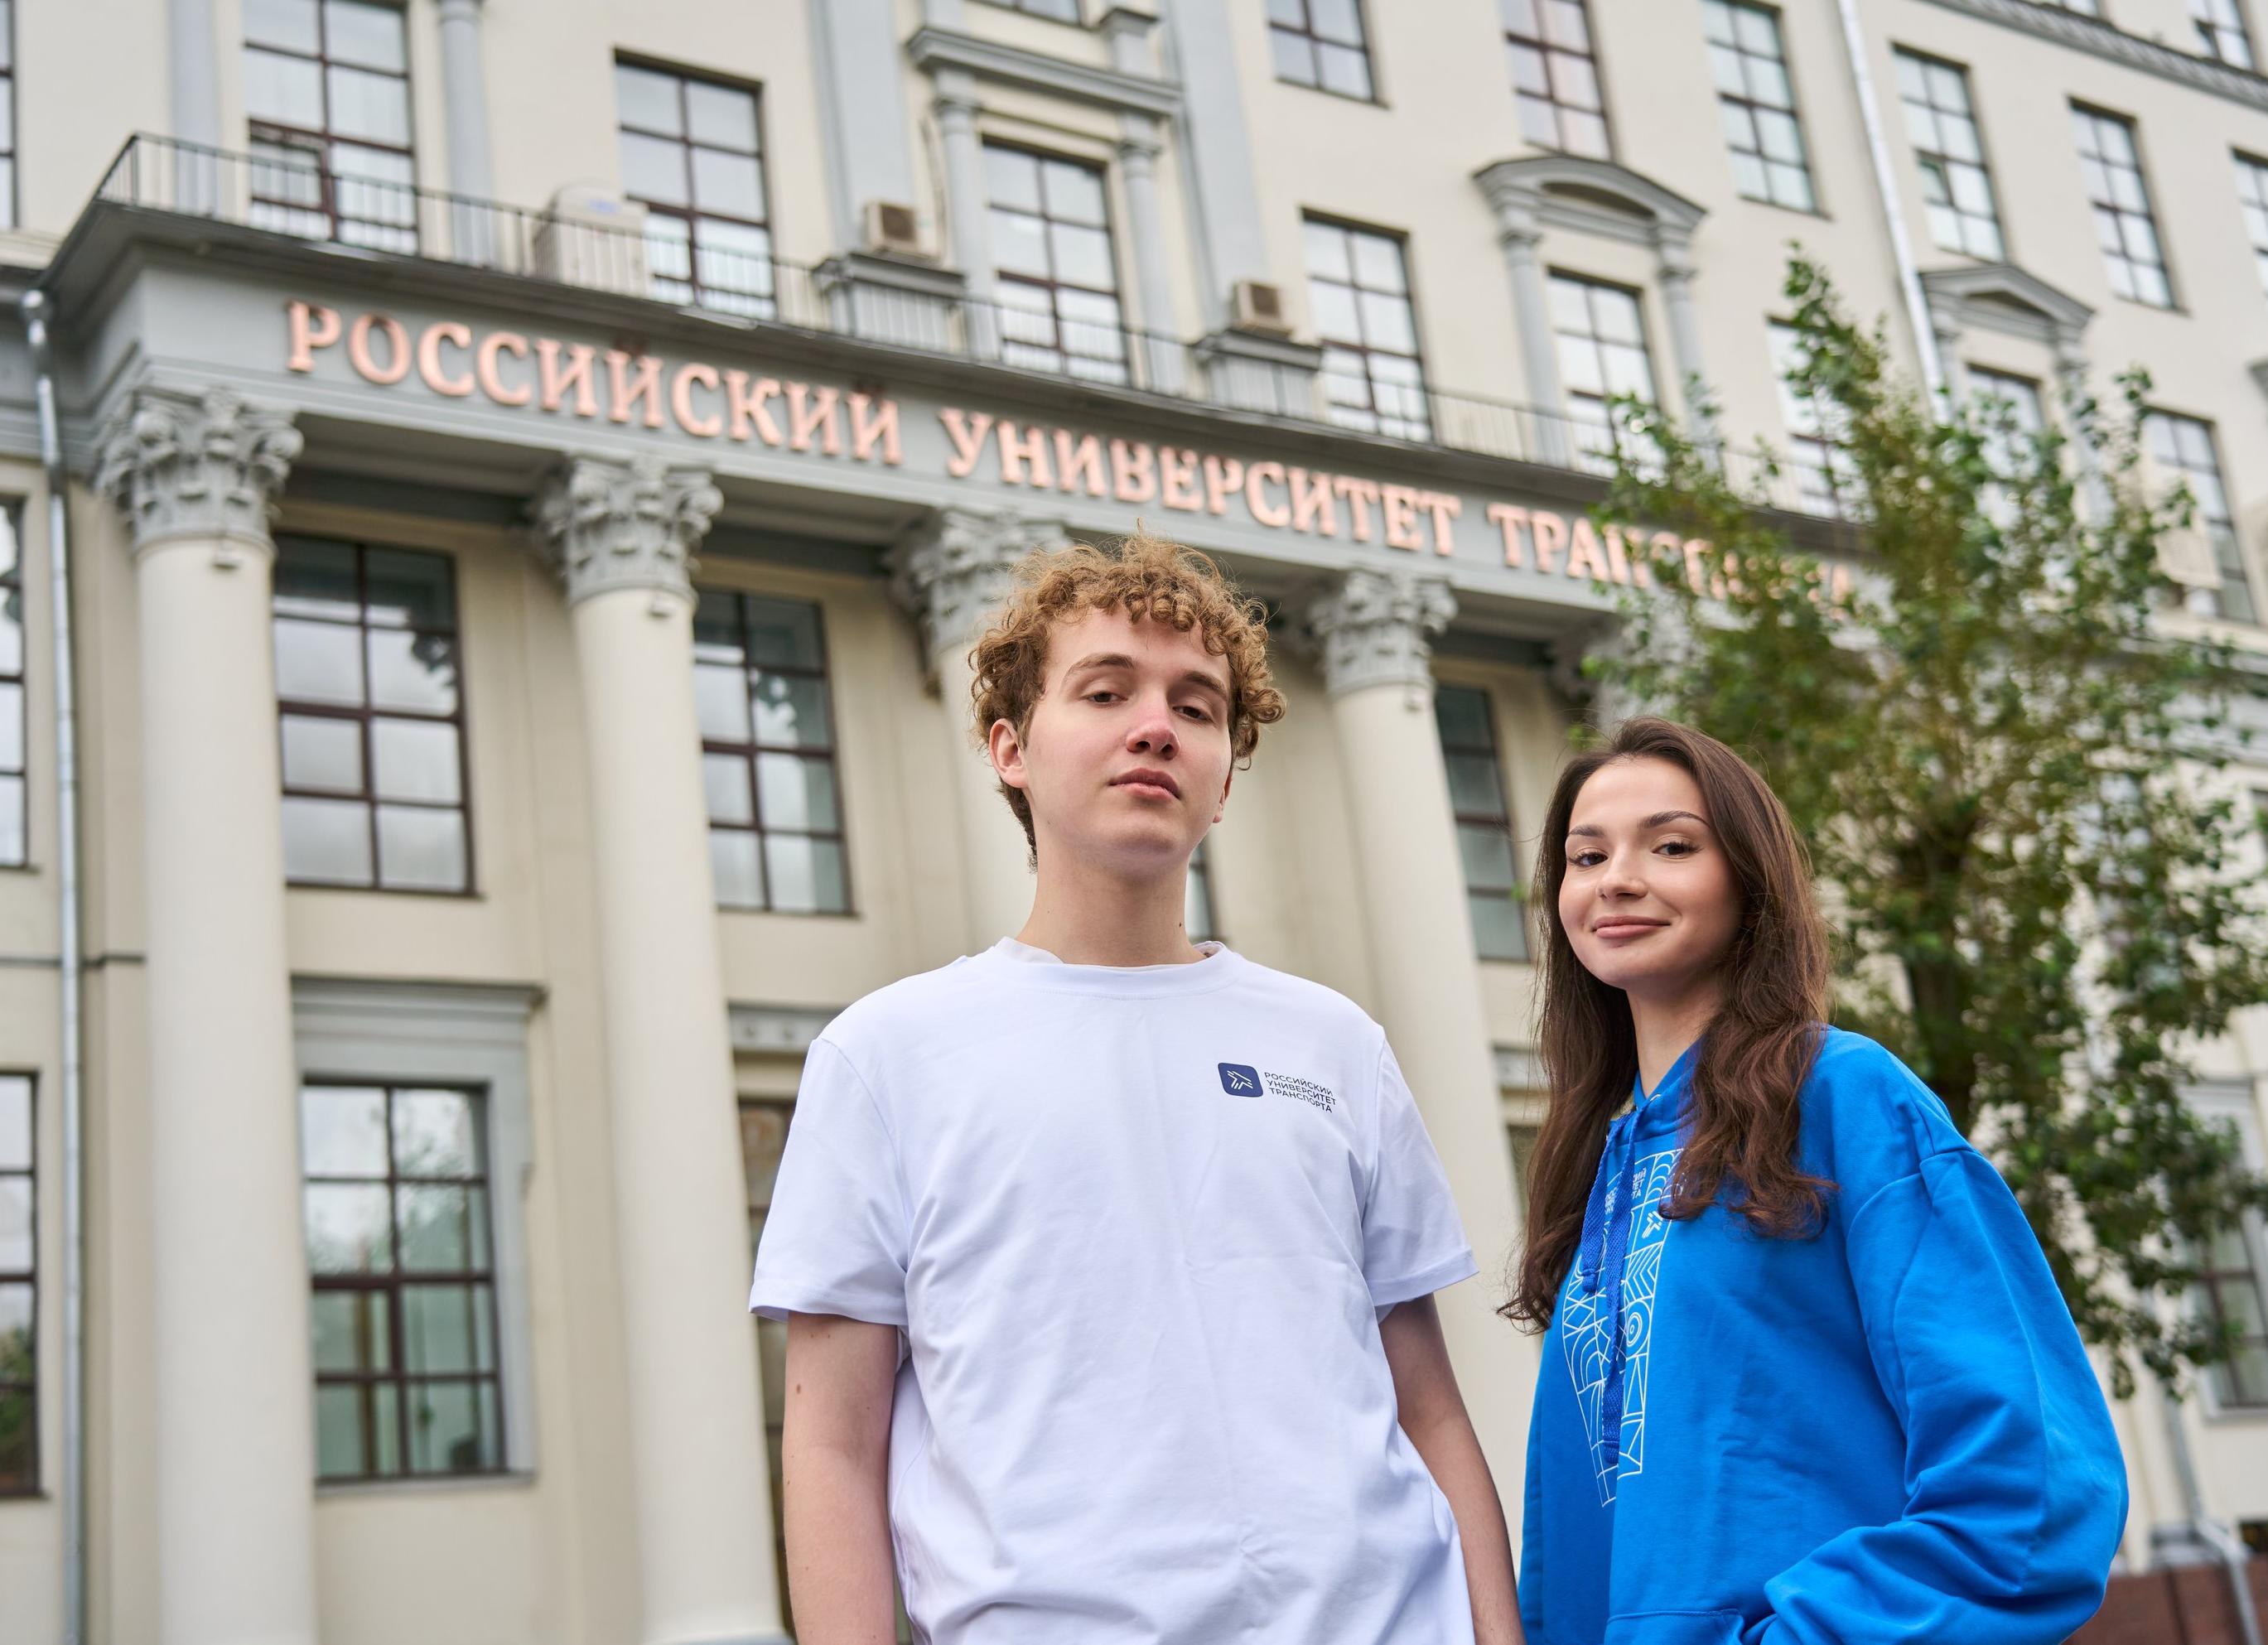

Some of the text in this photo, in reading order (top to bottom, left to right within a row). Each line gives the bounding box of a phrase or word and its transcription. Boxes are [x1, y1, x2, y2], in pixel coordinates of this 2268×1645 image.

[286, 299, 902, 466] РОССИЙСКИЙ
[939, 408, 1461, 556] УНИВЕРСИТЕТ
[1264, 1072, 1334, 1097] РОССИЙСКИЙ
[1267, 1080, 1336, 1105] УНИВЕРСИТЕТ
[1269, 1088, 1332, 1113] ТРАНСПОРТА
